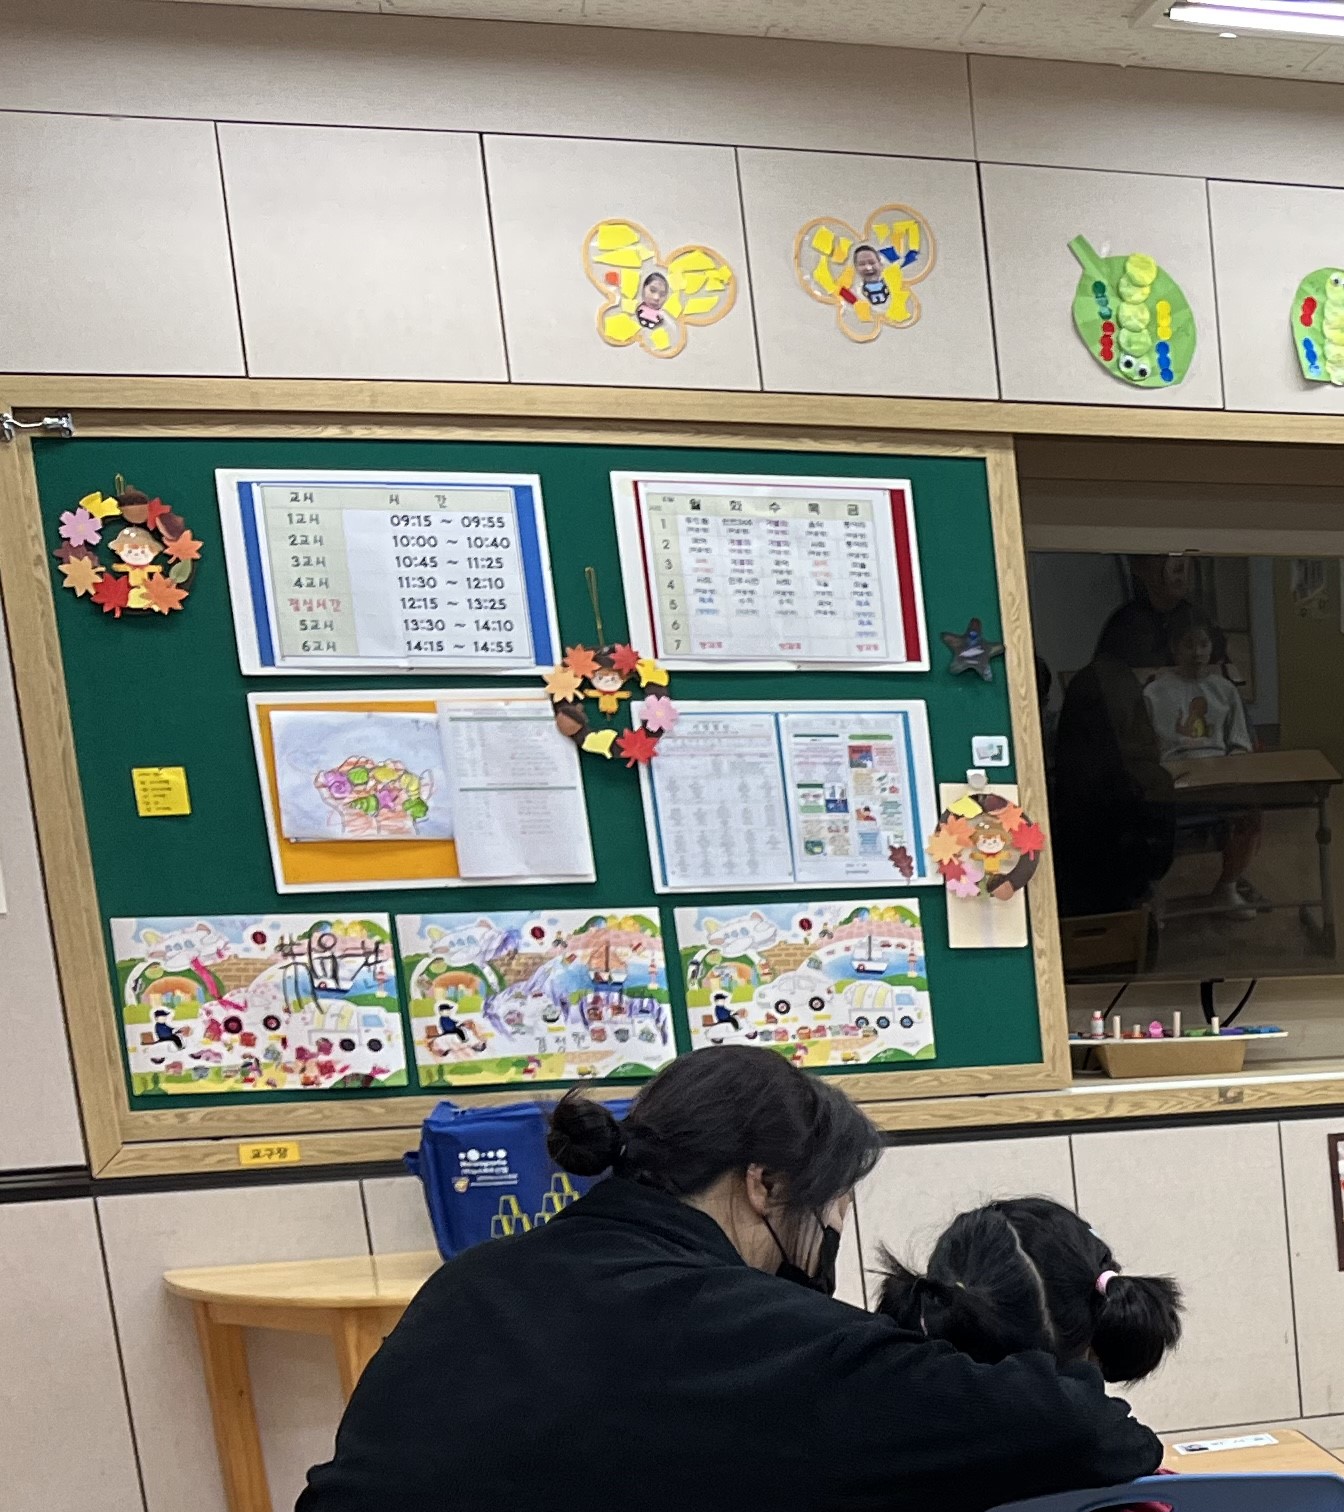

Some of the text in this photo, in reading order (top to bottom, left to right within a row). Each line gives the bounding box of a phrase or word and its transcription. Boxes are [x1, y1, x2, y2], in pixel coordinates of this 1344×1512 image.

[390, 515, 433, 527] 09:15
[460, 516, 506, 528] 09:55
[392, 535, 438, 548] 10:00
[466, 536, 511, 549] 10:40
[395, 555, 438, 569] 10:45
[467, 557, 504, 569] 11:25
[397, 576, 437, 589] 11:30
[466, 577, 505, 590] 12:10
[400, 597, 439, 610] 12:15
[467, 598, 508, 610] 13:25
[404, 619, 446, 631] 13:30
[475, 619, 515, 632] 14:10
[406, 640, 445, 652] 14:15
[473, 641, 514, 654] 14:55
